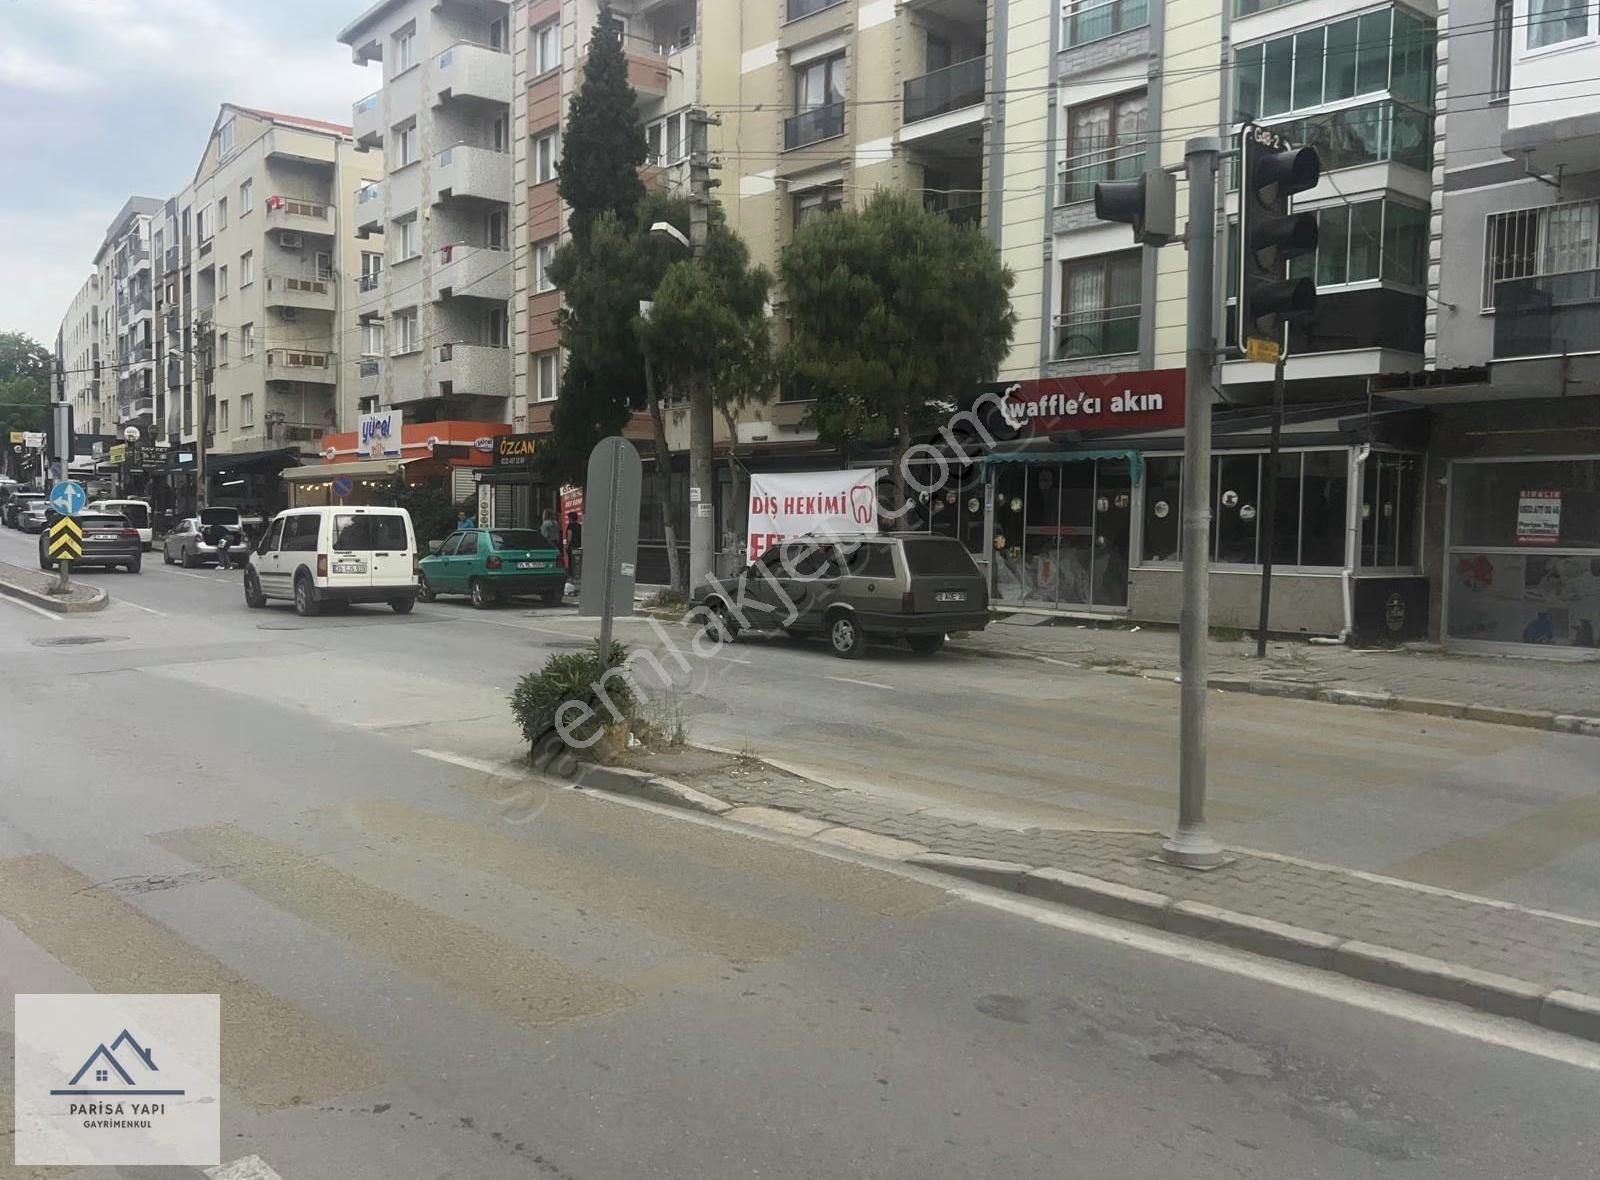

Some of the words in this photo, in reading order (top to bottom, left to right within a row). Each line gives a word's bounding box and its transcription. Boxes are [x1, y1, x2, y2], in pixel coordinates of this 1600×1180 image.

[1110, 389, 1164, 413] akın
[500, 436, 535, 456] ÖZCAN
[751, 492, 778, 519] DİŞ
[784, 491, 847, 515] HEKİMİ
